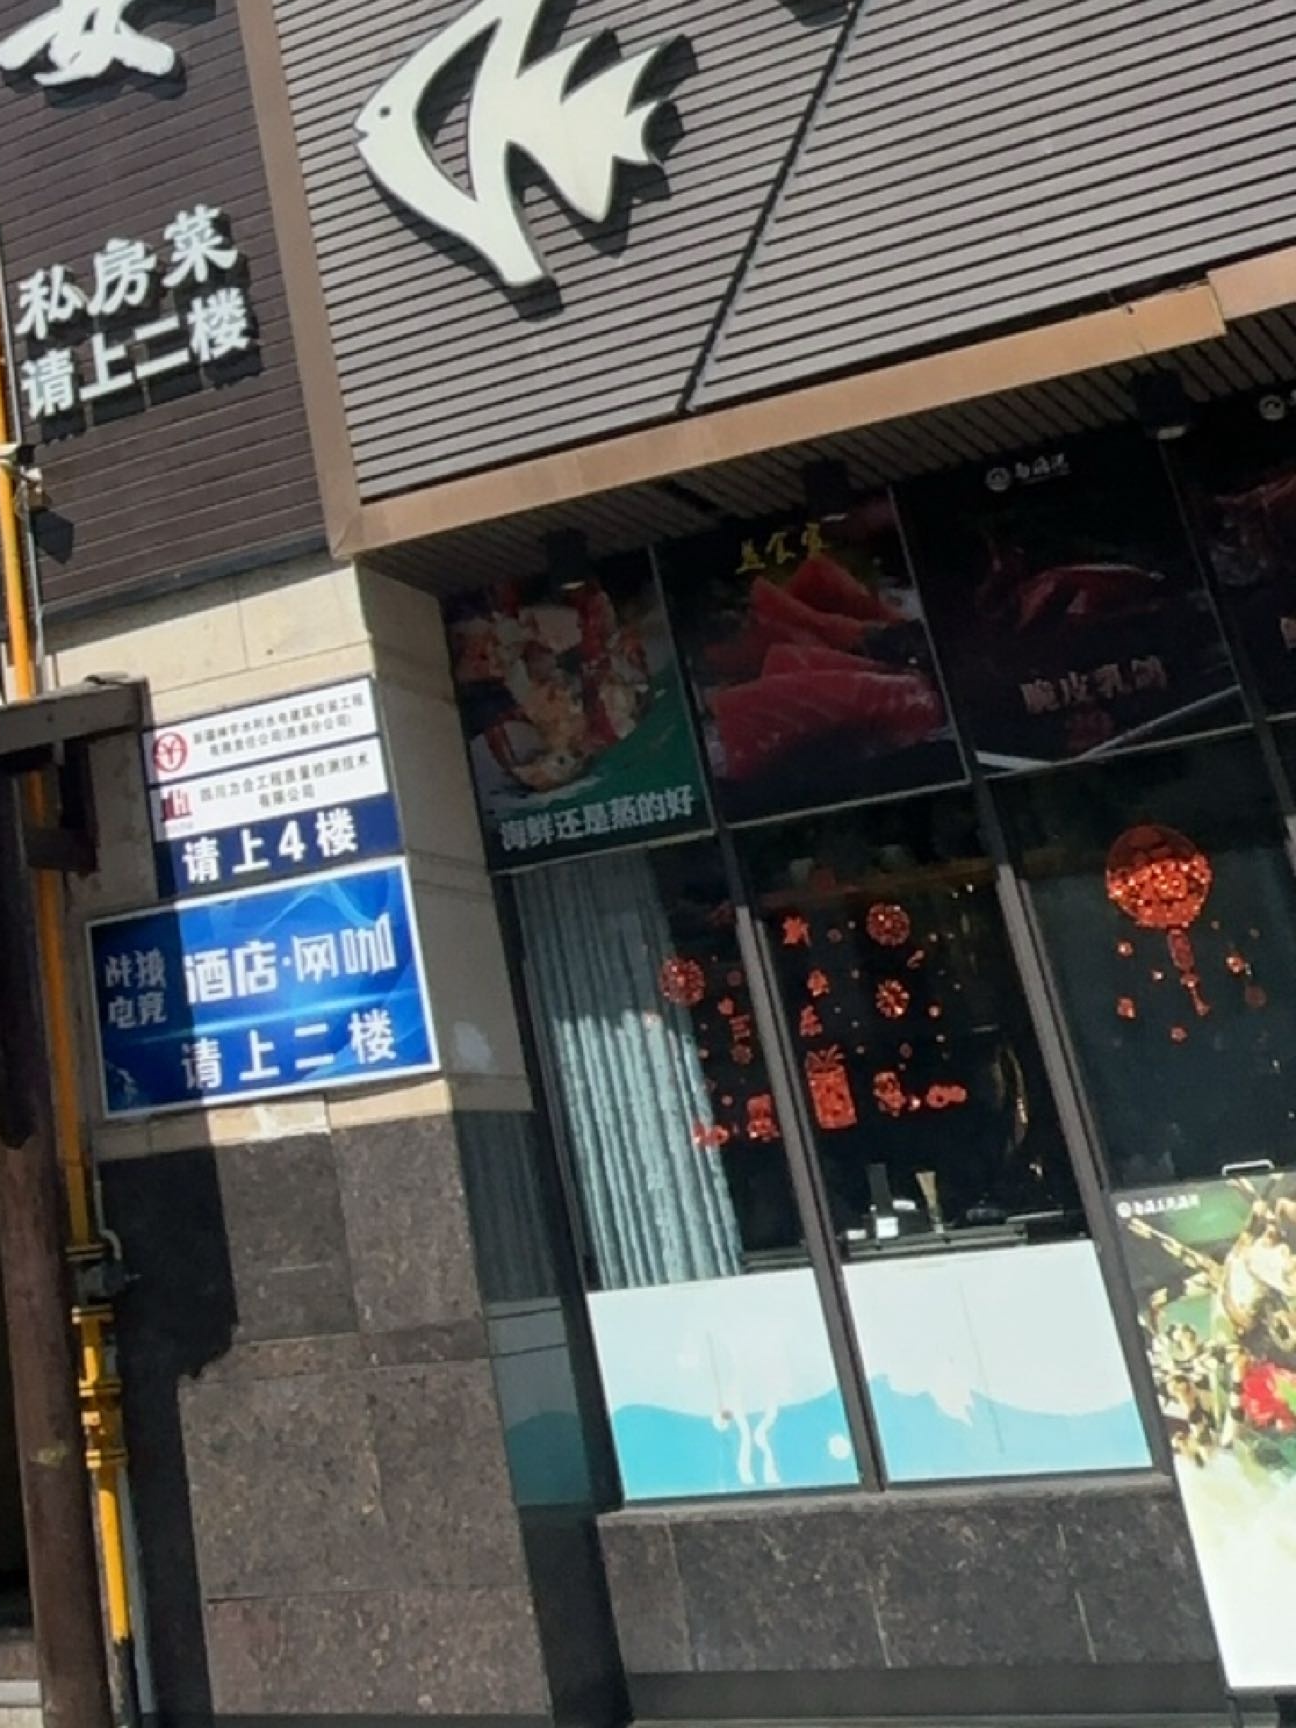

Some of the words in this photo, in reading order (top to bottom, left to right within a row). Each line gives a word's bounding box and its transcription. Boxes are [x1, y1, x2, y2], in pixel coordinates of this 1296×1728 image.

[16, 204, 239, 339] 私房菜
[22, 287, 252, 420] 请上二楼
[182, 807, 358, 882] 请上4楼
[500, 784, 694, 851] 海鲜还是蒸的好
[181, 1008, 397, 1090] 请上二楼
